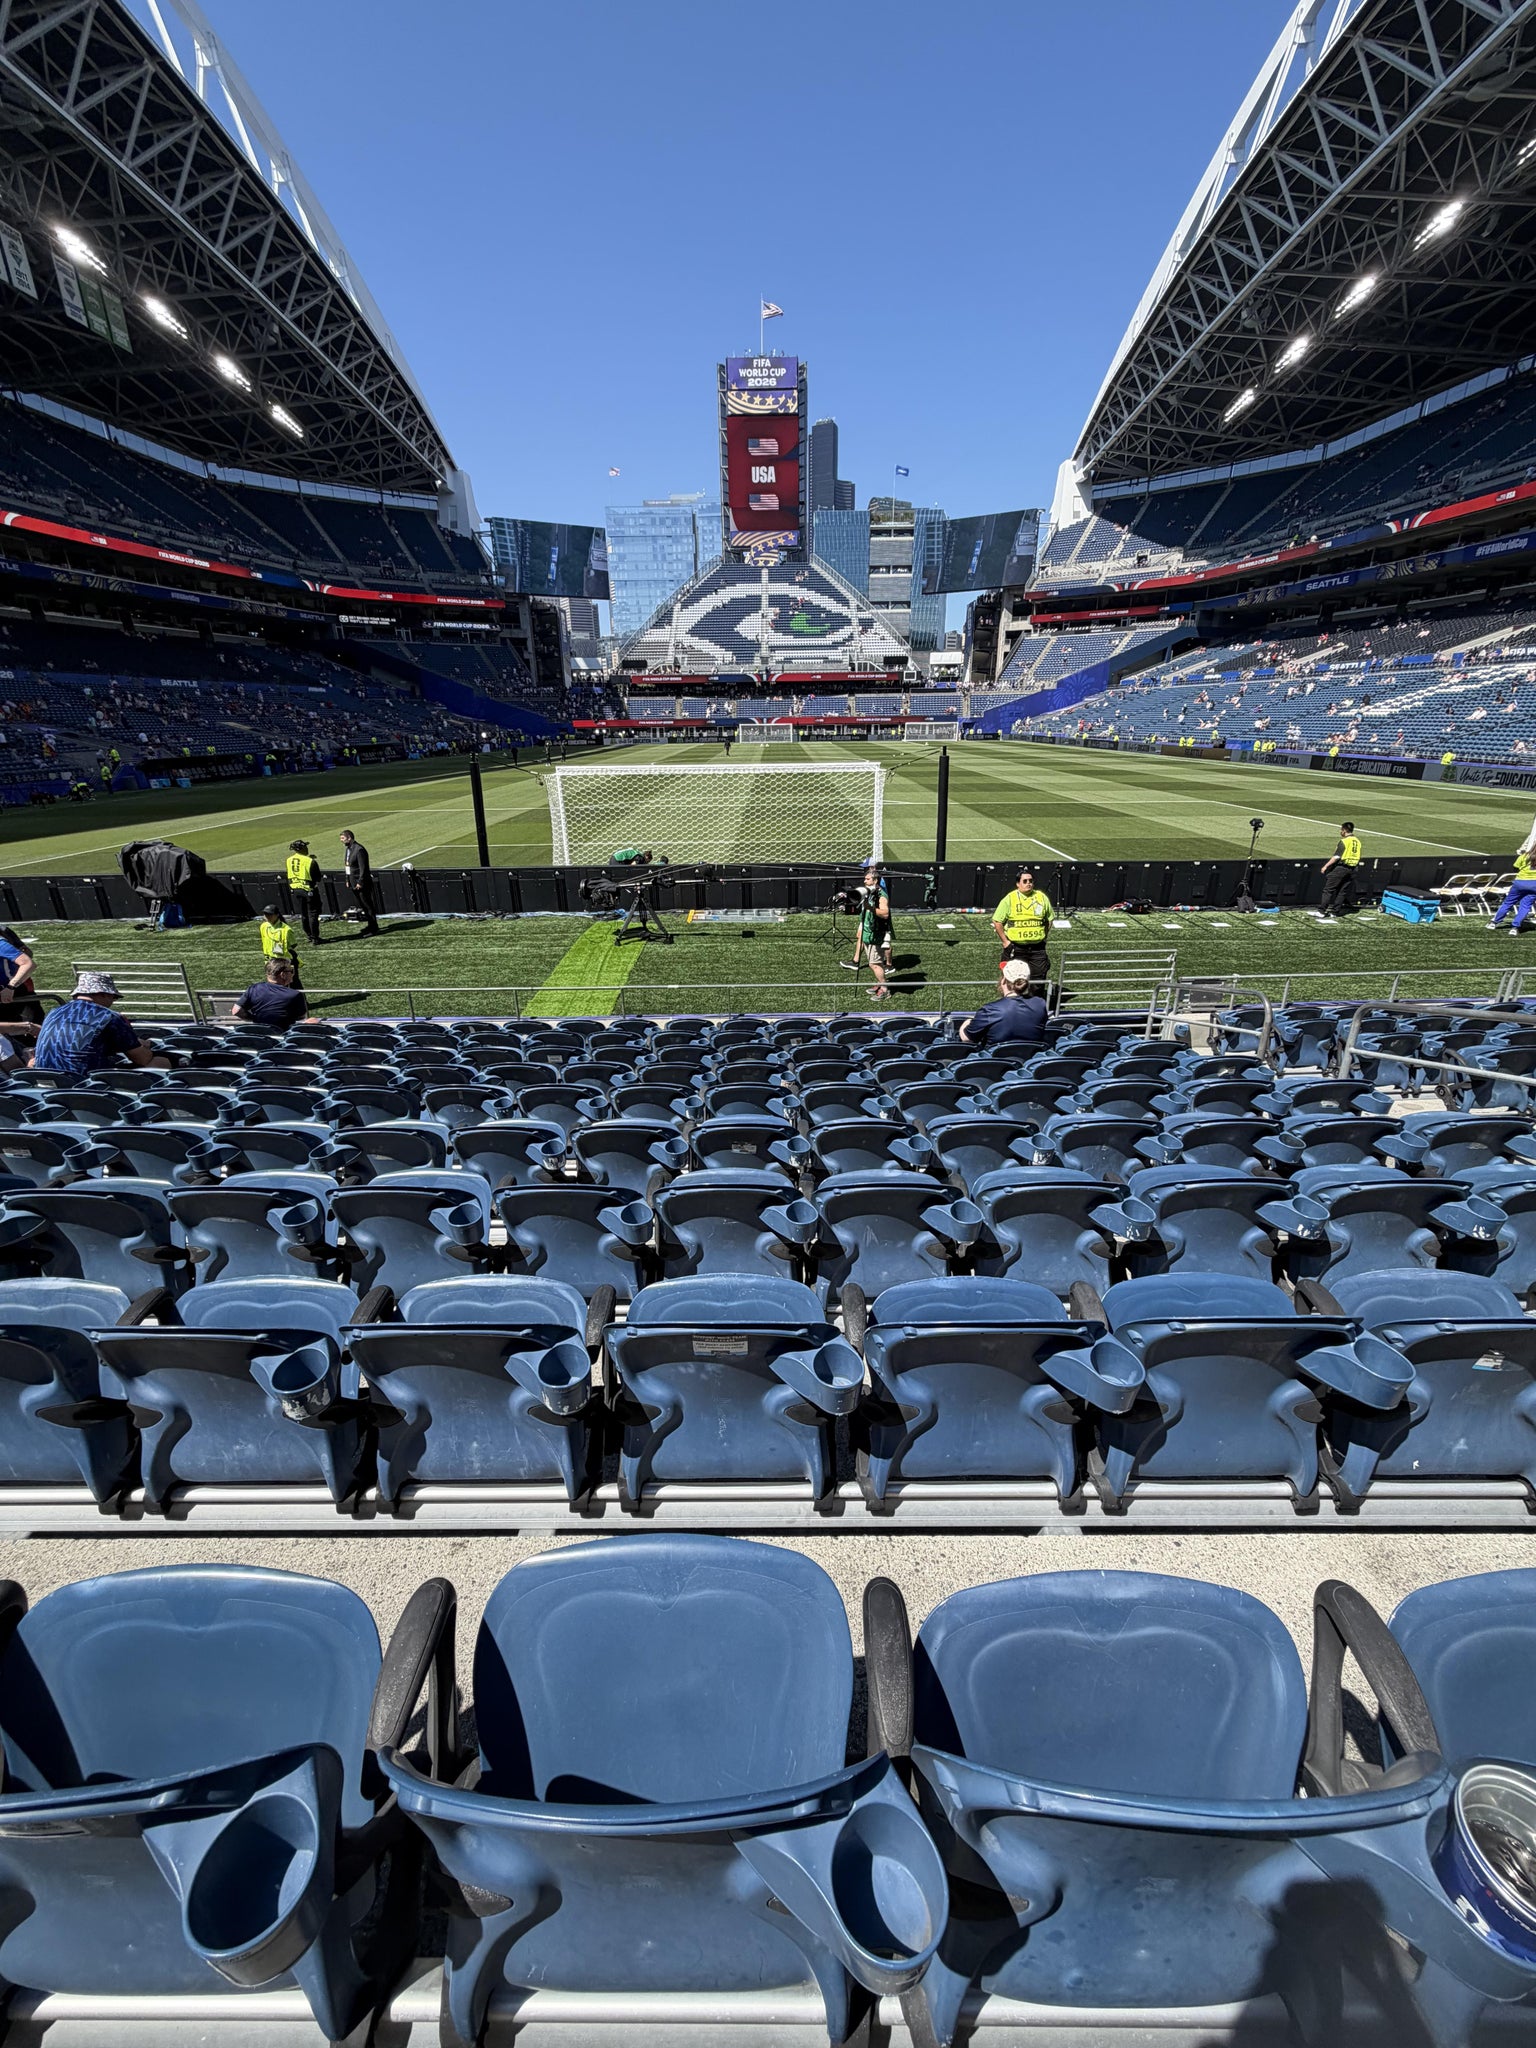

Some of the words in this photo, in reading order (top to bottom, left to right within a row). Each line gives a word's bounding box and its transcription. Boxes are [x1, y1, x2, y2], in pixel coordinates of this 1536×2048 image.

[753, 359, 772, 368] FIFA
[739, 368, 769, 377] WORLD
[770, 368, 787, 377] CUP
[748, 378, 777, 387] 2026
[751, 466, 776, 483] USA
[1305, 575, 1350, 591] SEATTLE
[299, 613, 325, 621] SEATTLE
[160, 678, 198, 688] SEATTLE
[1357, 760, 1392, 775] EDUCATION
[1392, 765, 1407, 774] FIFA
